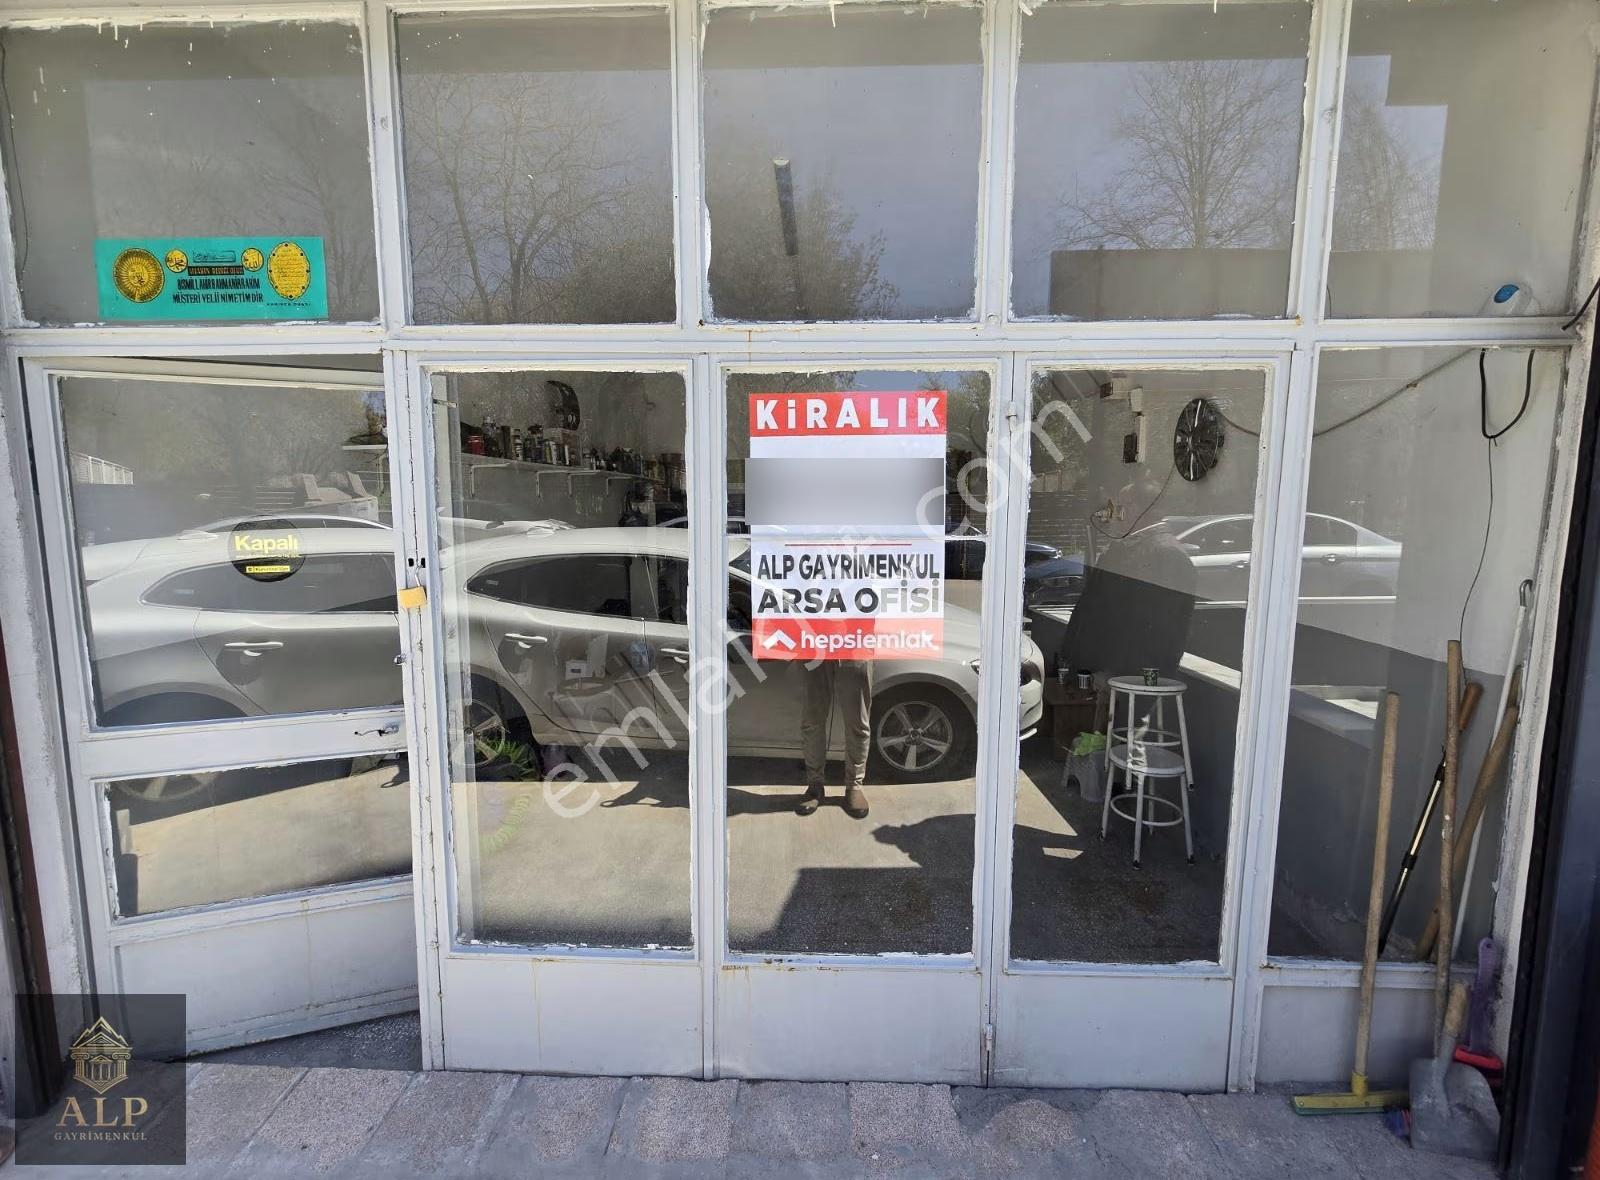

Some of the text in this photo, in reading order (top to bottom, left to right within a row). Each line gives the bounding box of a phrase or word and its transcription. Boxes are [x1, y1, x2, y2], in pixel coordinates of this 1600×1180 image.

[234, 534, 298, 554] Kapalı
[757, 546, 940, 581] ALP GAYRİMENKUL
[757, 579, 940, 614] ARSA OFİSİ
[801, 629, 939, 653] hepsiemlak
